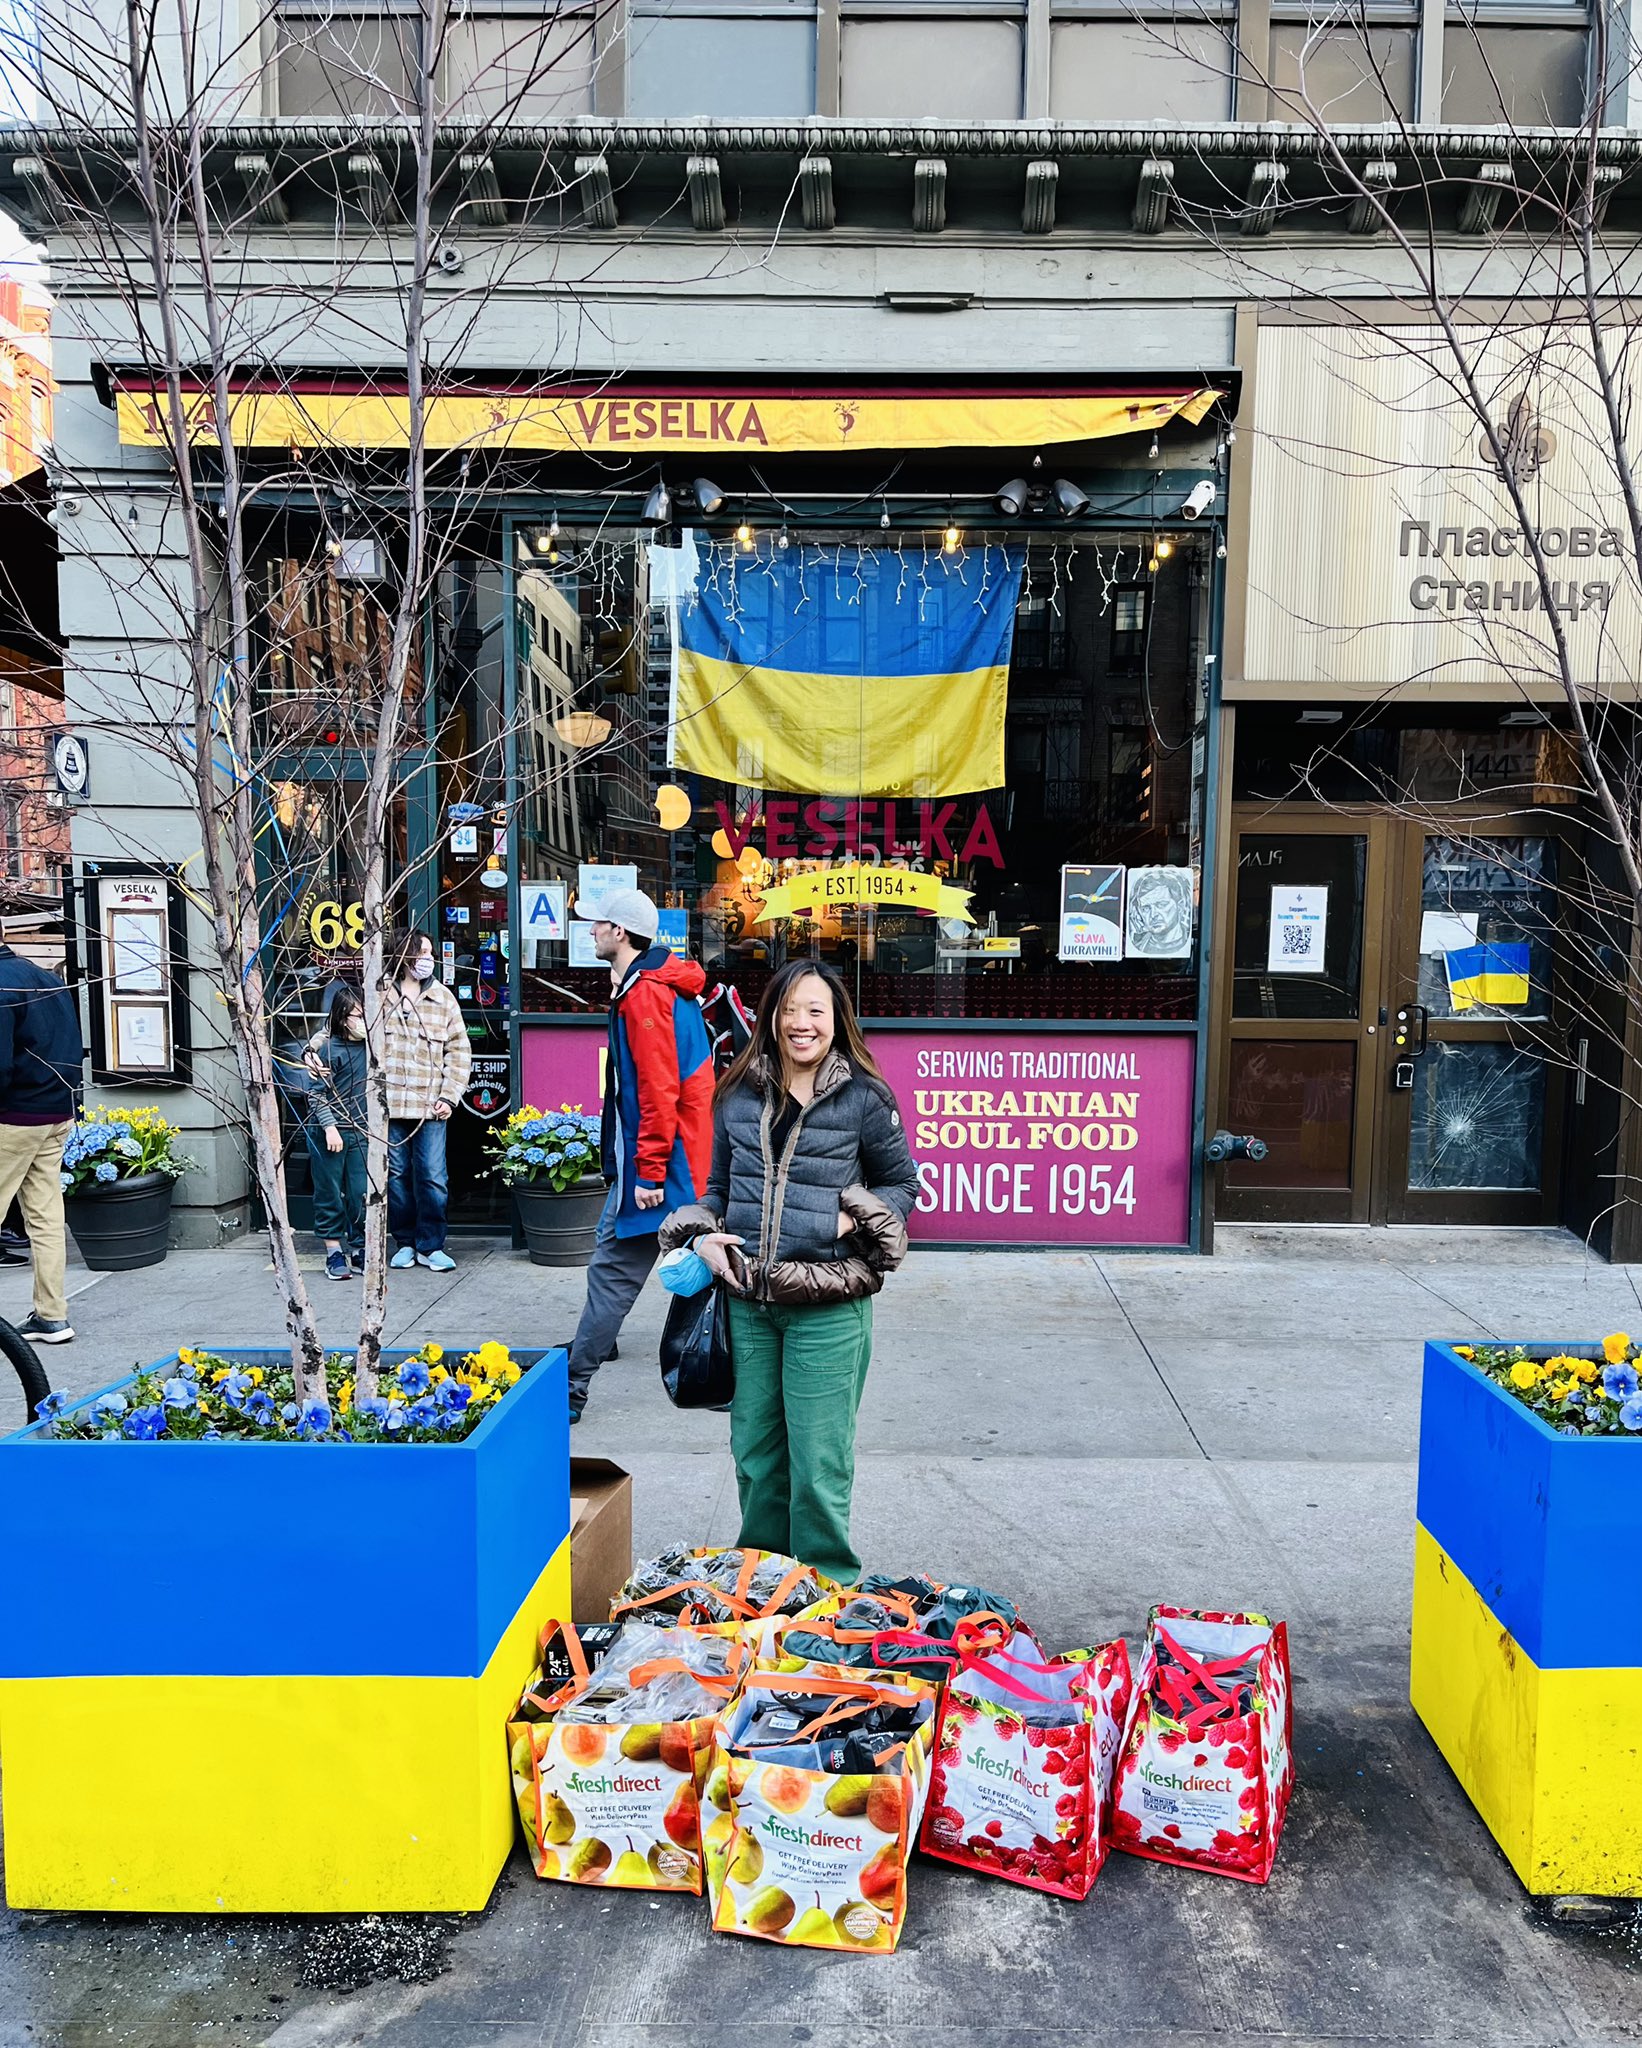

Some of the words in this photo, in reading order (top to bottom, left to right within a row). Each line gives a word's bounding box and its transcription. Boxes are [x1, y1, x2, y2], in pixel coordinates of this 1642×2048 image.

[140, 401, 218, 434] 14
[574, 401, 769, 446] VESELKA
[1399, 520, 1625, 557] Пластова
[1409, 574, 1611, 621] Станиця
[715, 799, 1005, 870] VESELKA
[114, 884, 158, 895] VESELKA
[826, 876, 860, 896] EST.
[865, 876, 905, 896] 1954
[529, 893, 557, 924] A
[1074, 933, 1106, 944] SLAVA
[483, 1062, 507, 1073] SHIP
[916, 1050, 1004, 1079] SERVING
[1009, 1051, 1141, 1080] TRADITIONAL
[913, 1089, 1141, 1118] UKRAINIAN
[915, 1120, 1021, 1150] SOUL
[1027, 1122, 1139, 1151] FOOD
[914, 1161, 1035, 1214] SINCE
[1048, 1163, 1137, 1216] 1954
[570, 1771, 663, 1794] freshdirect
[974, 1746, 1050, 1798] freshdirect
[1144, 1760, 1232, 1793] freshdirect
[978, 1785, 991, 1795] GET
[992, 1790, 1010, 1801] FREE
[606, 1813, 648, 1821] DeliveryPass
[767, 1814, 863, 1852] freshdirect
[778, 1851, 792, 1860] GET
[793, 1855, 810, 1866] FREE
[812, 1861, 849, 1870] DELIVERY
[781, 1861, 797, 1871] With
[798, 1865, 842, 1877] DeliveryPass
